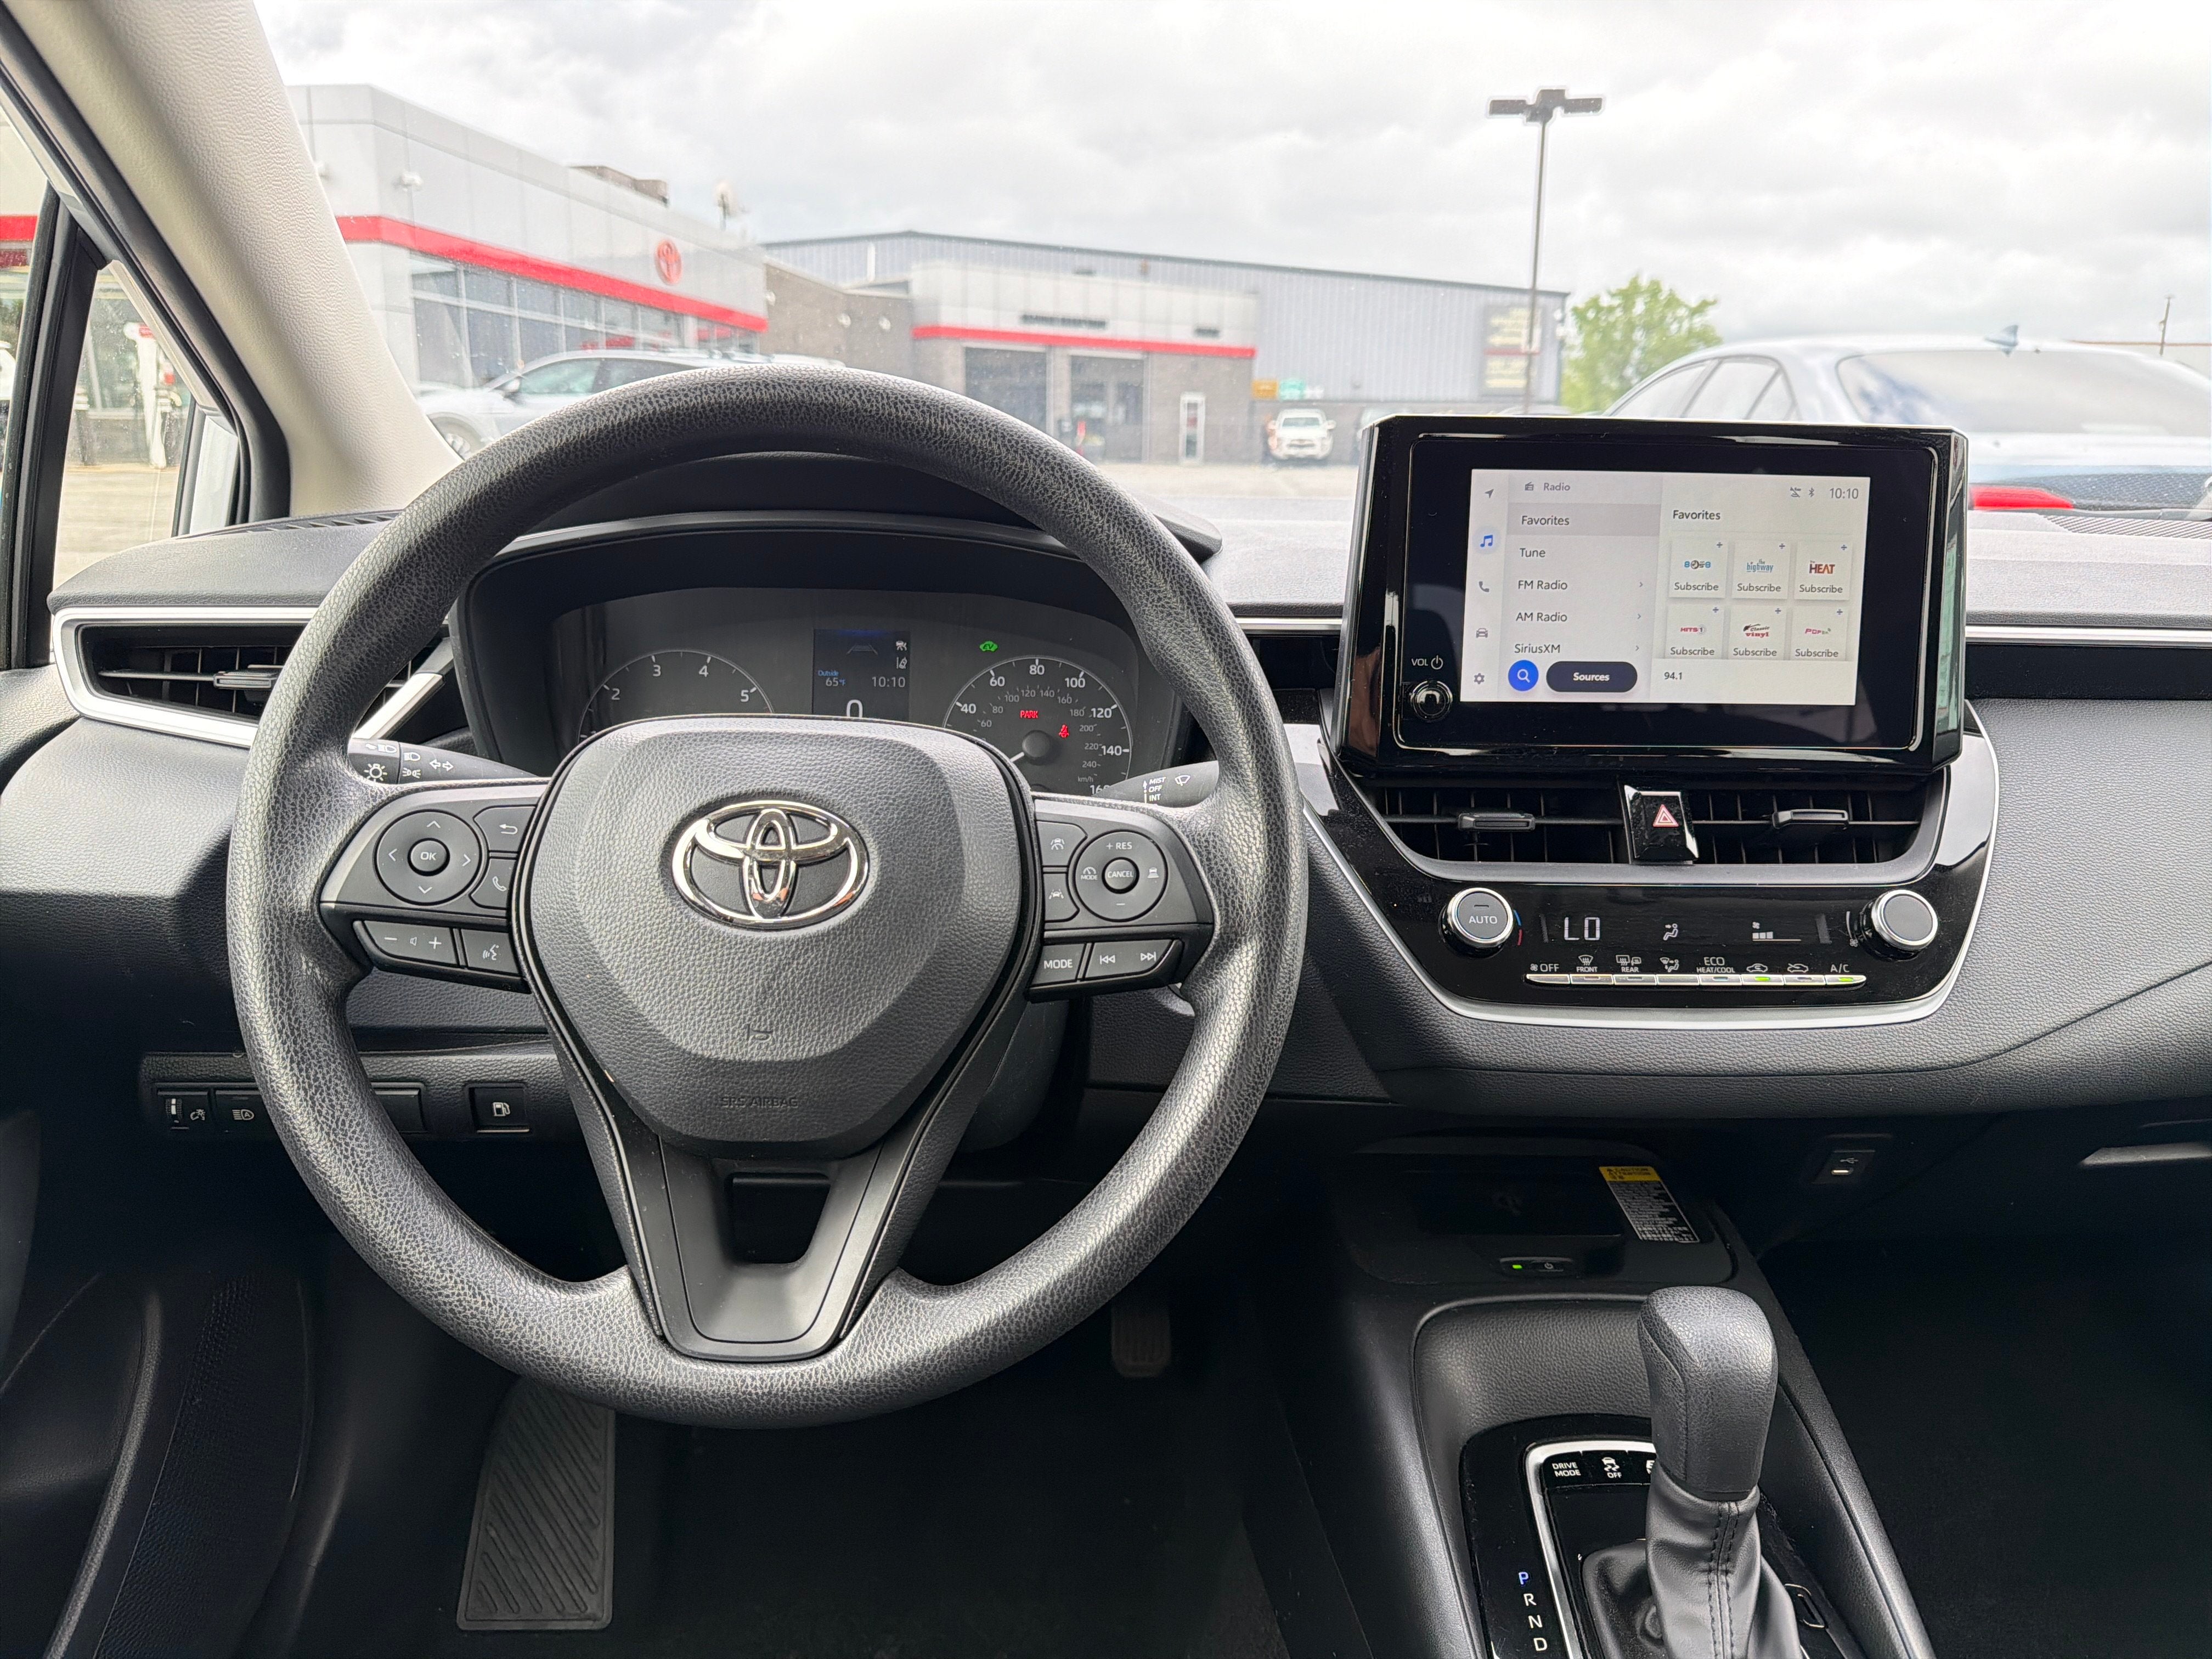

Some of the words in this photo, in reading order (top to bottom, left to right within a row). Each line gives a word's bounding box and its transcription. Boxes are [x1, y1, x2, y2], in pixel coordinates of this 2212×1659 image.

[1543, 482, 1571, 491] Radio
[1829, 488, 1859, 499] 10:10
[1672, 510, 1721, 520] Favorites
[1521, 515, 1570, 526] Favorites
[1519, 548, 1546, 558] Tune
[1809, 563, 1836, 574] HEAT
[1517, 580, 1534, 590] FM
[1536, 579, 1568, 590] Radio
[1674, 582, 1719, 591] Subscribe
[1736, 583, 1782, 592] Subscribe
[1799, 584, 1843, 593] Subscribe
[1515, 612, 1533, 622] AM
[1536, 612, 1567, 622] Radio
[1514, 644, 1561, 653] SiriusXM
[1670, 647, 1715, 656] Subscribe
[1733, 648, 1778, 657] Subscribe
[1795, 648, 1839, 658] Subscribe
[653, 664, 662, 677] 3
[698, 665, 709, 678] 4
[1029, 664, 1045, 675] 80
[1572, 672, 1610, 681] Sources
[1664, 672, 1683, 680] 94.1
[872, 676, 906, 688] 10:10
[989, 676, 1006, 687] 60
[1064, 677, 1086, 688] 100
[611, 687, 620, 701] 2
[740, 689, 749, 702] 5
[1021, 690, 1036, 698] 120
[1040, 690, 1055, 698] 140
[1057, 696, 1073, 704] 160
[846, 699, 864, 718] 0
[960, 703, 977, 714] 40
[992, 706, 1003, 714] 80
[1070, 708, 1085, 717] 180
[1091, 707, 1113, 719] 120
[1019, 710, 1039, 719] PARK
[980, 719, 992, 727] 60
[1079, 724, 1094, 732] 200
[1101, 744, 1122, 756] 140
[1149, 776, 1166, 785] MIST
[1149, 793, 1161, 802] INT
[420, 851, 437, 861] OK
[1107, 870, 1134, 878] CANCEL
[1468, 915, 1498, 924] AUTO
[1564, 917, 1600, 941] LO
[1043, 959, 1073, 969] MODE
[1703, 957, 1725, 966] ECO
[1539, 963, 1560, 972] OFF
[1830, 964, 1850, 973] A/C
[749, 1097, 799, 1108] AIRBAG
[1551, 1462, 1578, 1470] DRIVE
[1554, 1469, 1582, 1477] MODE
[1518, 1571, 1530, 1585] P
[1523, 1593, 1537, 1606] R
[1528, 1615, 1543, 1629] N
[1533, 1637, 1548, 1651] D
